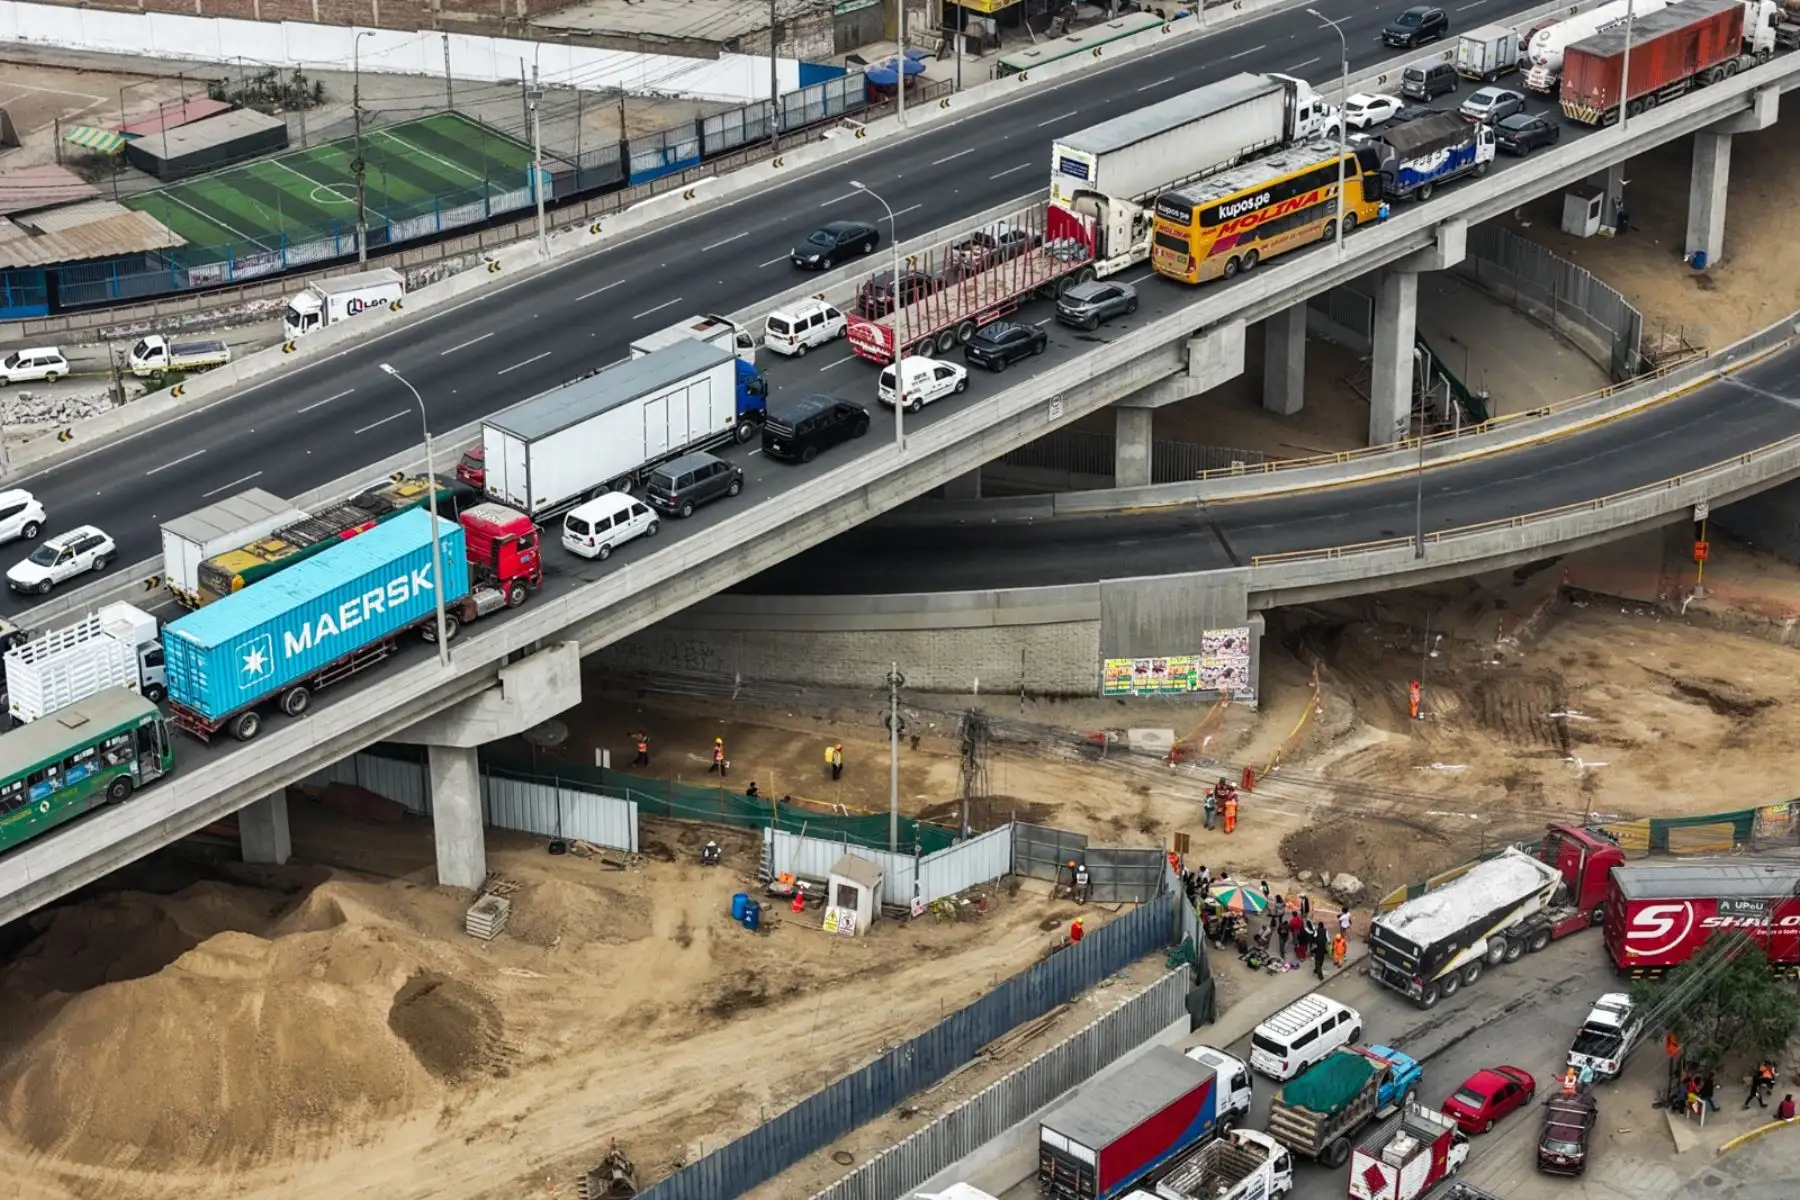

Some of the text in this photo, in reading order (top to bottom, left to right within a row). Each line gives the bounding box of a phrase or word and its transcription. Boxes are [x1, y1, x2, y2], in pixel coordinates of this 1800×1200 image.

[1217, 191, 1319, 237] MOLINA
[1219, 191, 1271, 219] kupos.pe
[283, 562, 434, 659] MAERSK
